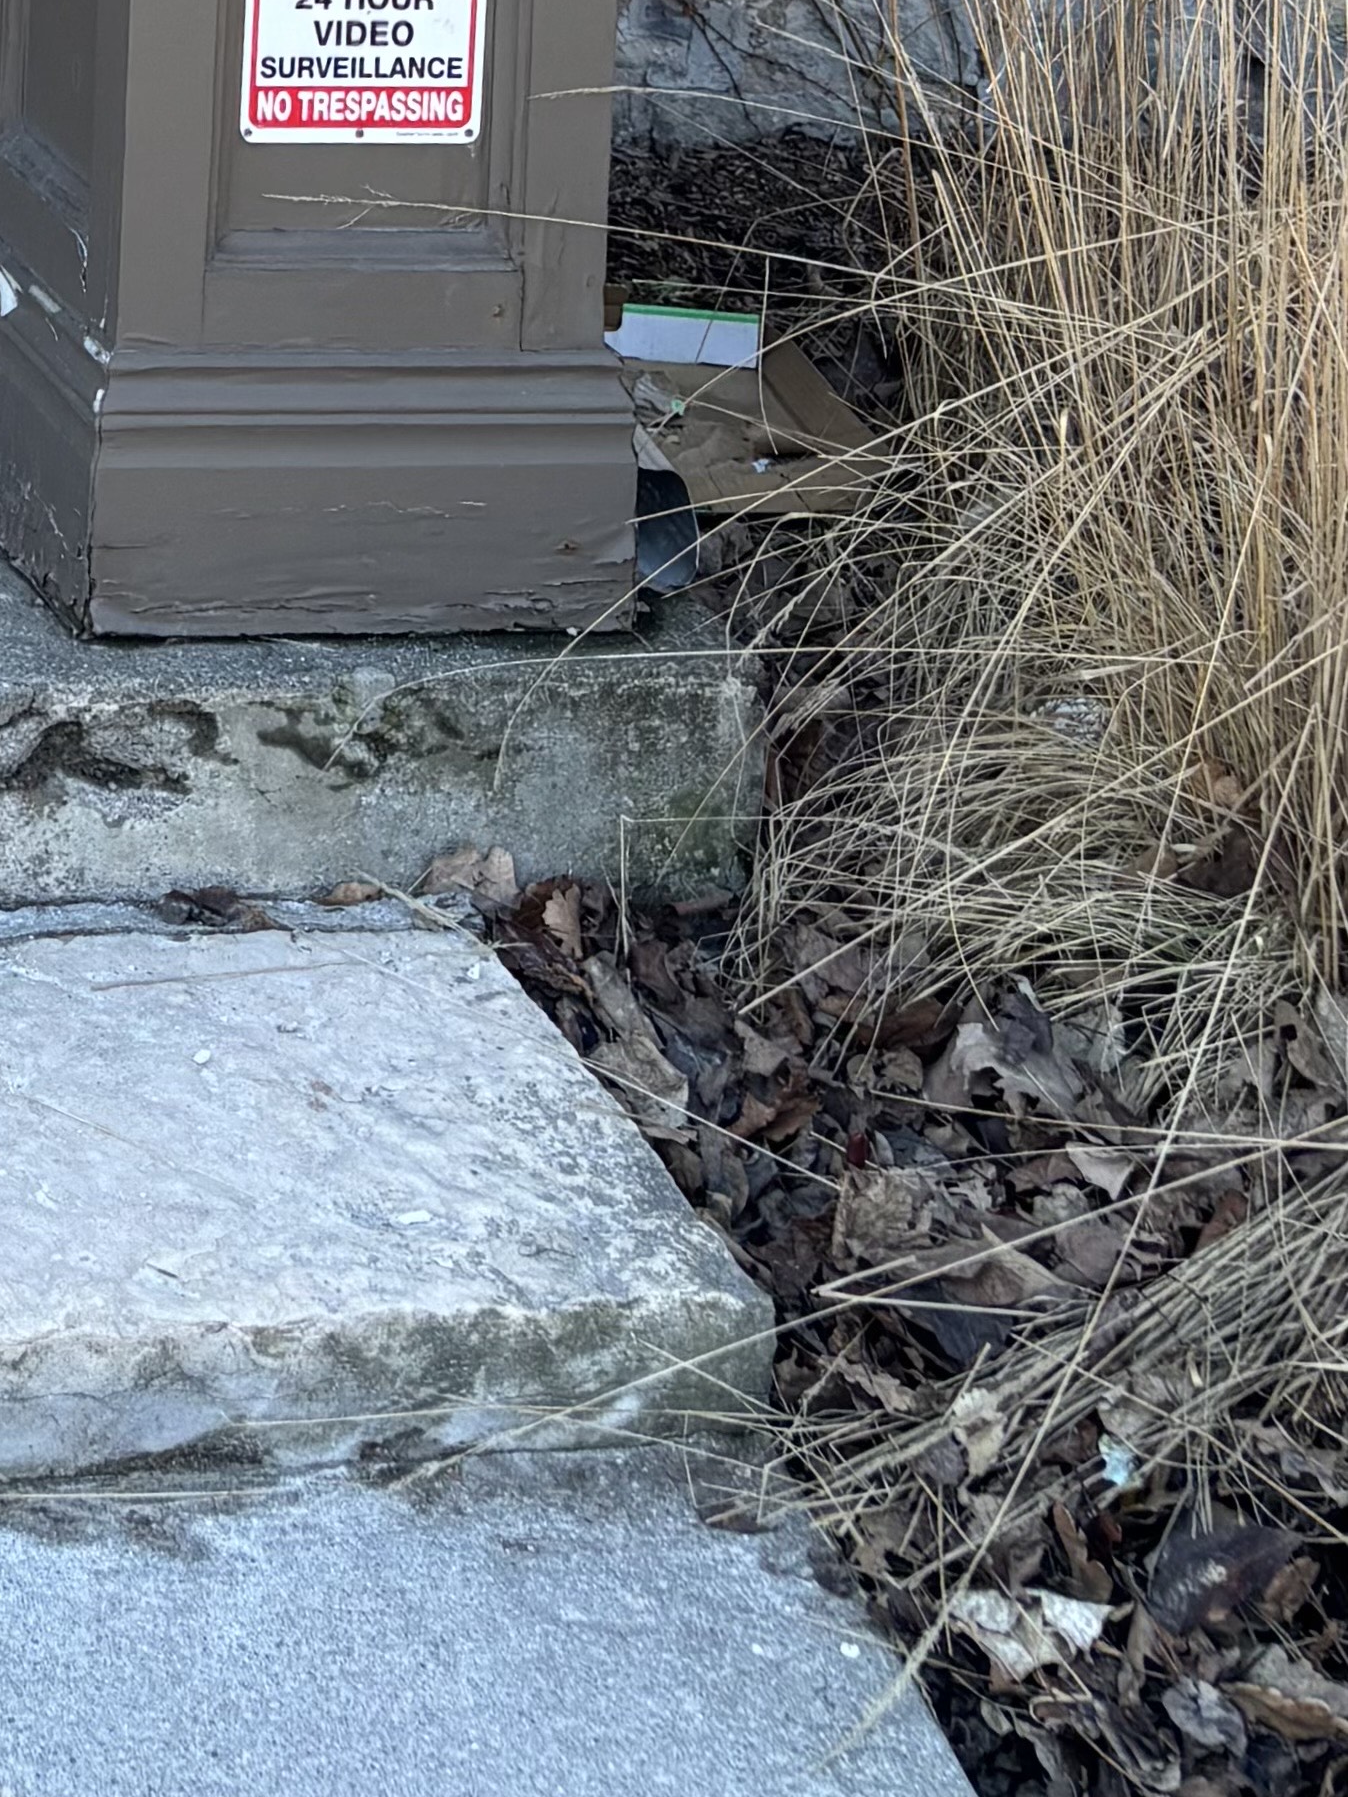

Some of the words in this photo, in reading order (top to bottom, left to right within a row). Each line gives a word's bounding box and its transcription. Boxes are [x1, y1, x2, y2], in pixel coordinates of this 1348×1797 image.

[314, 20, 414, 47] VIDEO
[260, 56, 463, 79] SURVEILLANCE
[257, 90, 292, 121] NO
[297, 91, 464, 122] TRESPASSING
